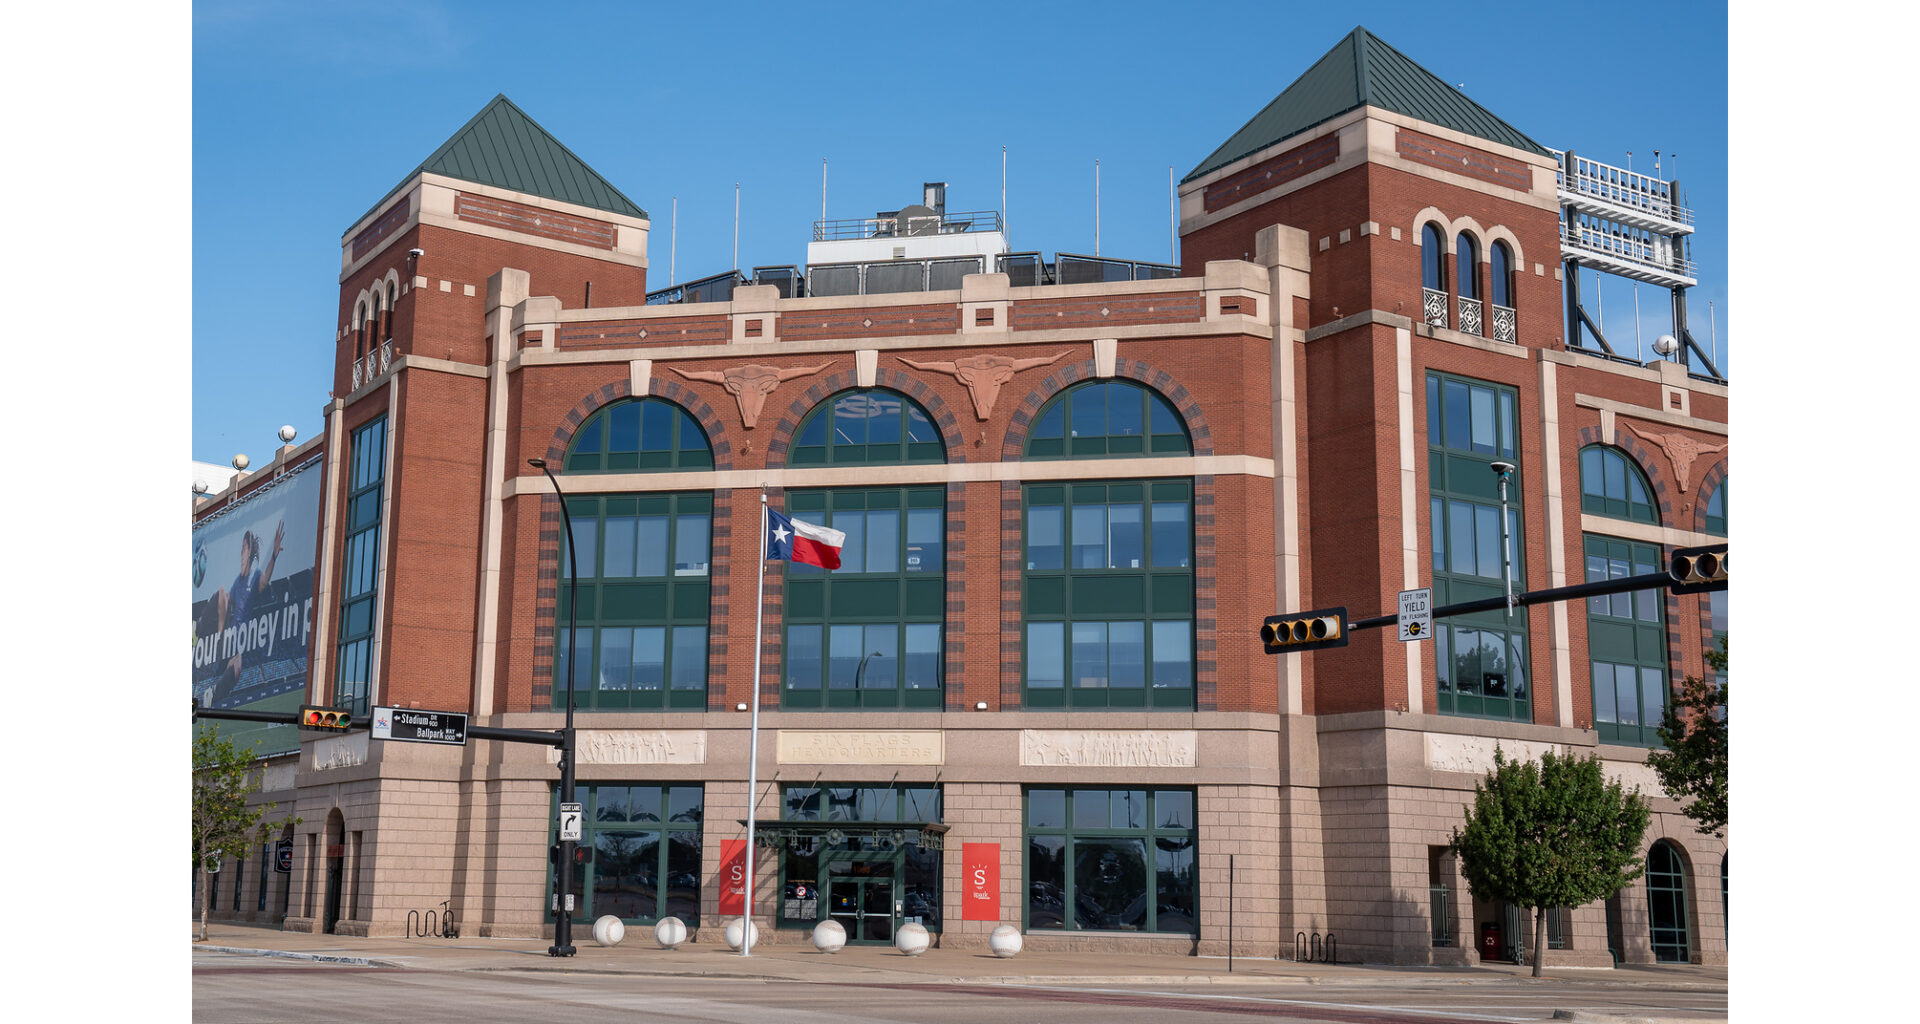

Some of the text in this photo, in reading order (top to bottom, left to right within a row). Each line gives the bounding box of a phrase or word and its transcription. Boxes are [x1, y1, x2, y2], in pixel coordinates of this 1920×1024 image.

[1404, 601, 1425, 612] YIELD
[222, 610, 279, 660] money
[282, 591, 299, 640] in
[401, 713, 428, 725] Stadium
[417, 727, 444, 739] Ballpark
[812, 734, 911, 746] SIX FLAGS
[792, 747, 932, 759] HEADQUARTERS
[731, 865, 743, 880] S
[974, 869, 986, 885] S
